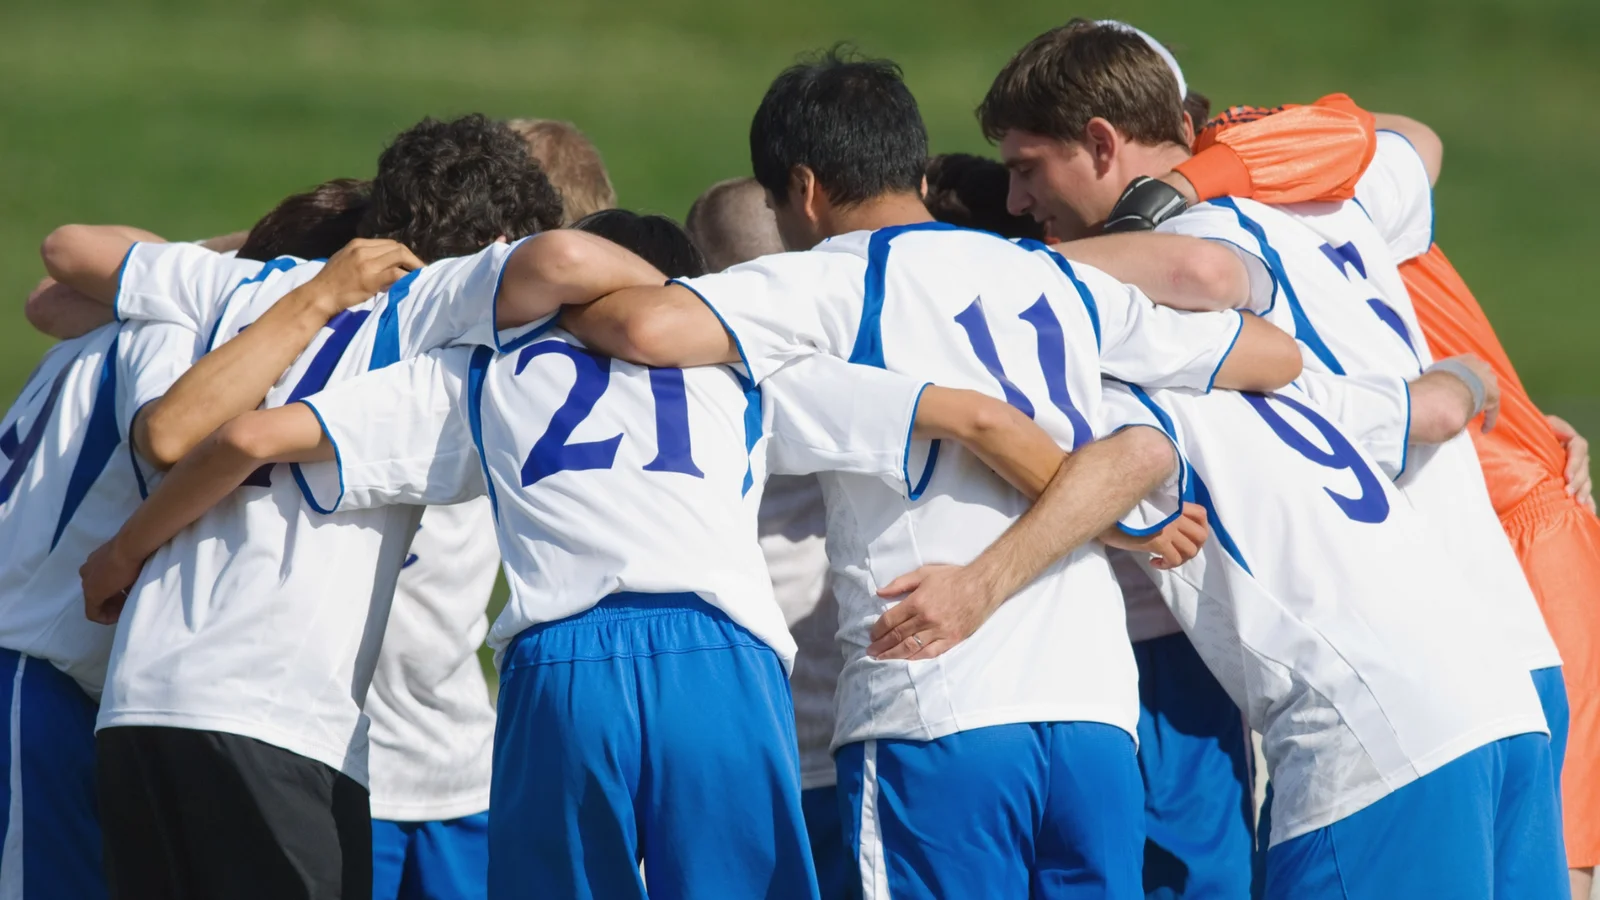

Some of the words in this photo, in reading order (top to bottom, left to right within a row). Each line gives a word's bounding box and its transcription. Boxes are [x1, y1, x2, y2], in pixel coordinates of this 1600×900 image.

[515, 339, 705, 488] 21
[953, 292, 1093, 453] 11
[1239, 390, 1390, 524] 9
